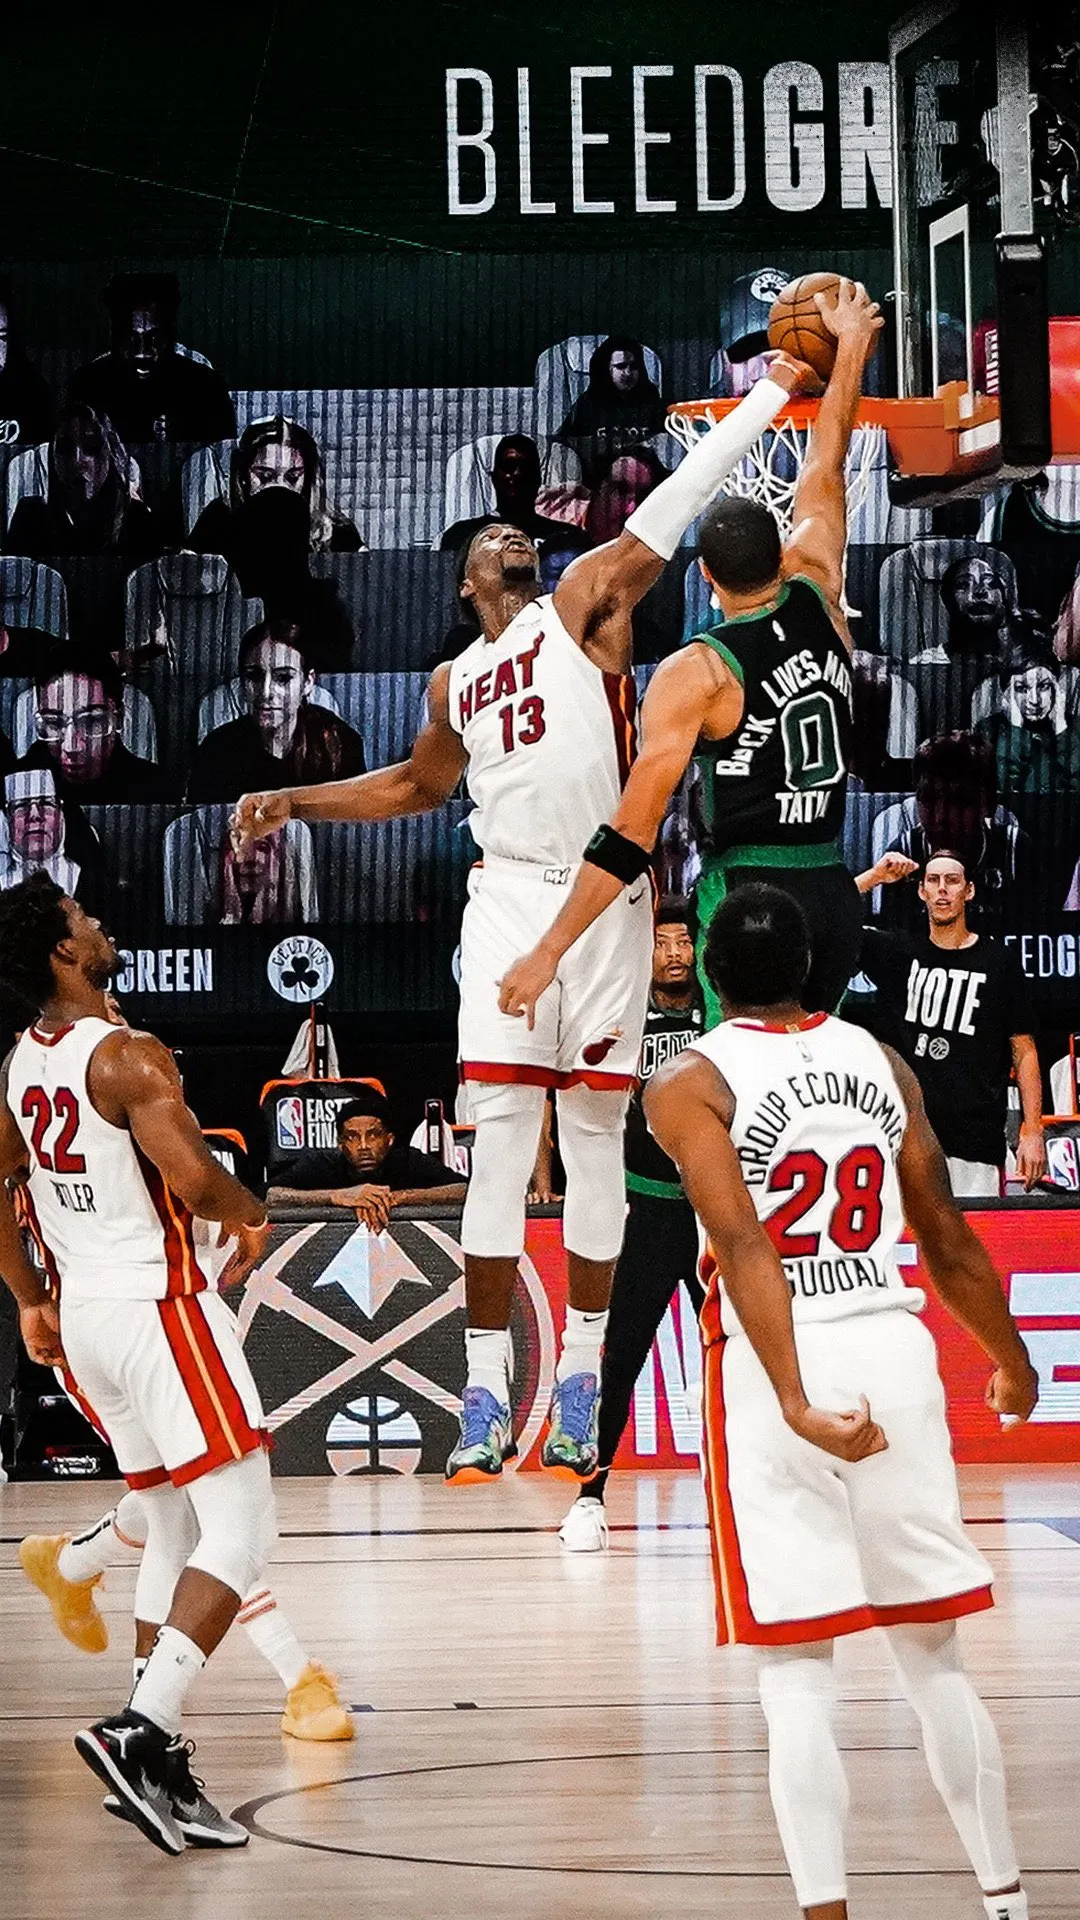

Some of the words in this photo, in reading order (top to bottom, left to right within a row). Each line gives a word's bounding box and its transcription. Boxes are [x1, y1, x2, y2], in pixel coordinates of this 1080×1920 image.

[458, 631, 546, 731] HEAT
[761, 649, 822, 708] LIVES
[498, 695, 546, 754] 13
[780, 690, 845, 791] 0
[104, 948, 214, 994] GREEN
[904, 958, 987, 1036] VOTE
[21, 1085, 87, 1174] 22
[787, 1071, 903, 1166] ECONOMIC
[763, 1143, 885, 1259] 28
